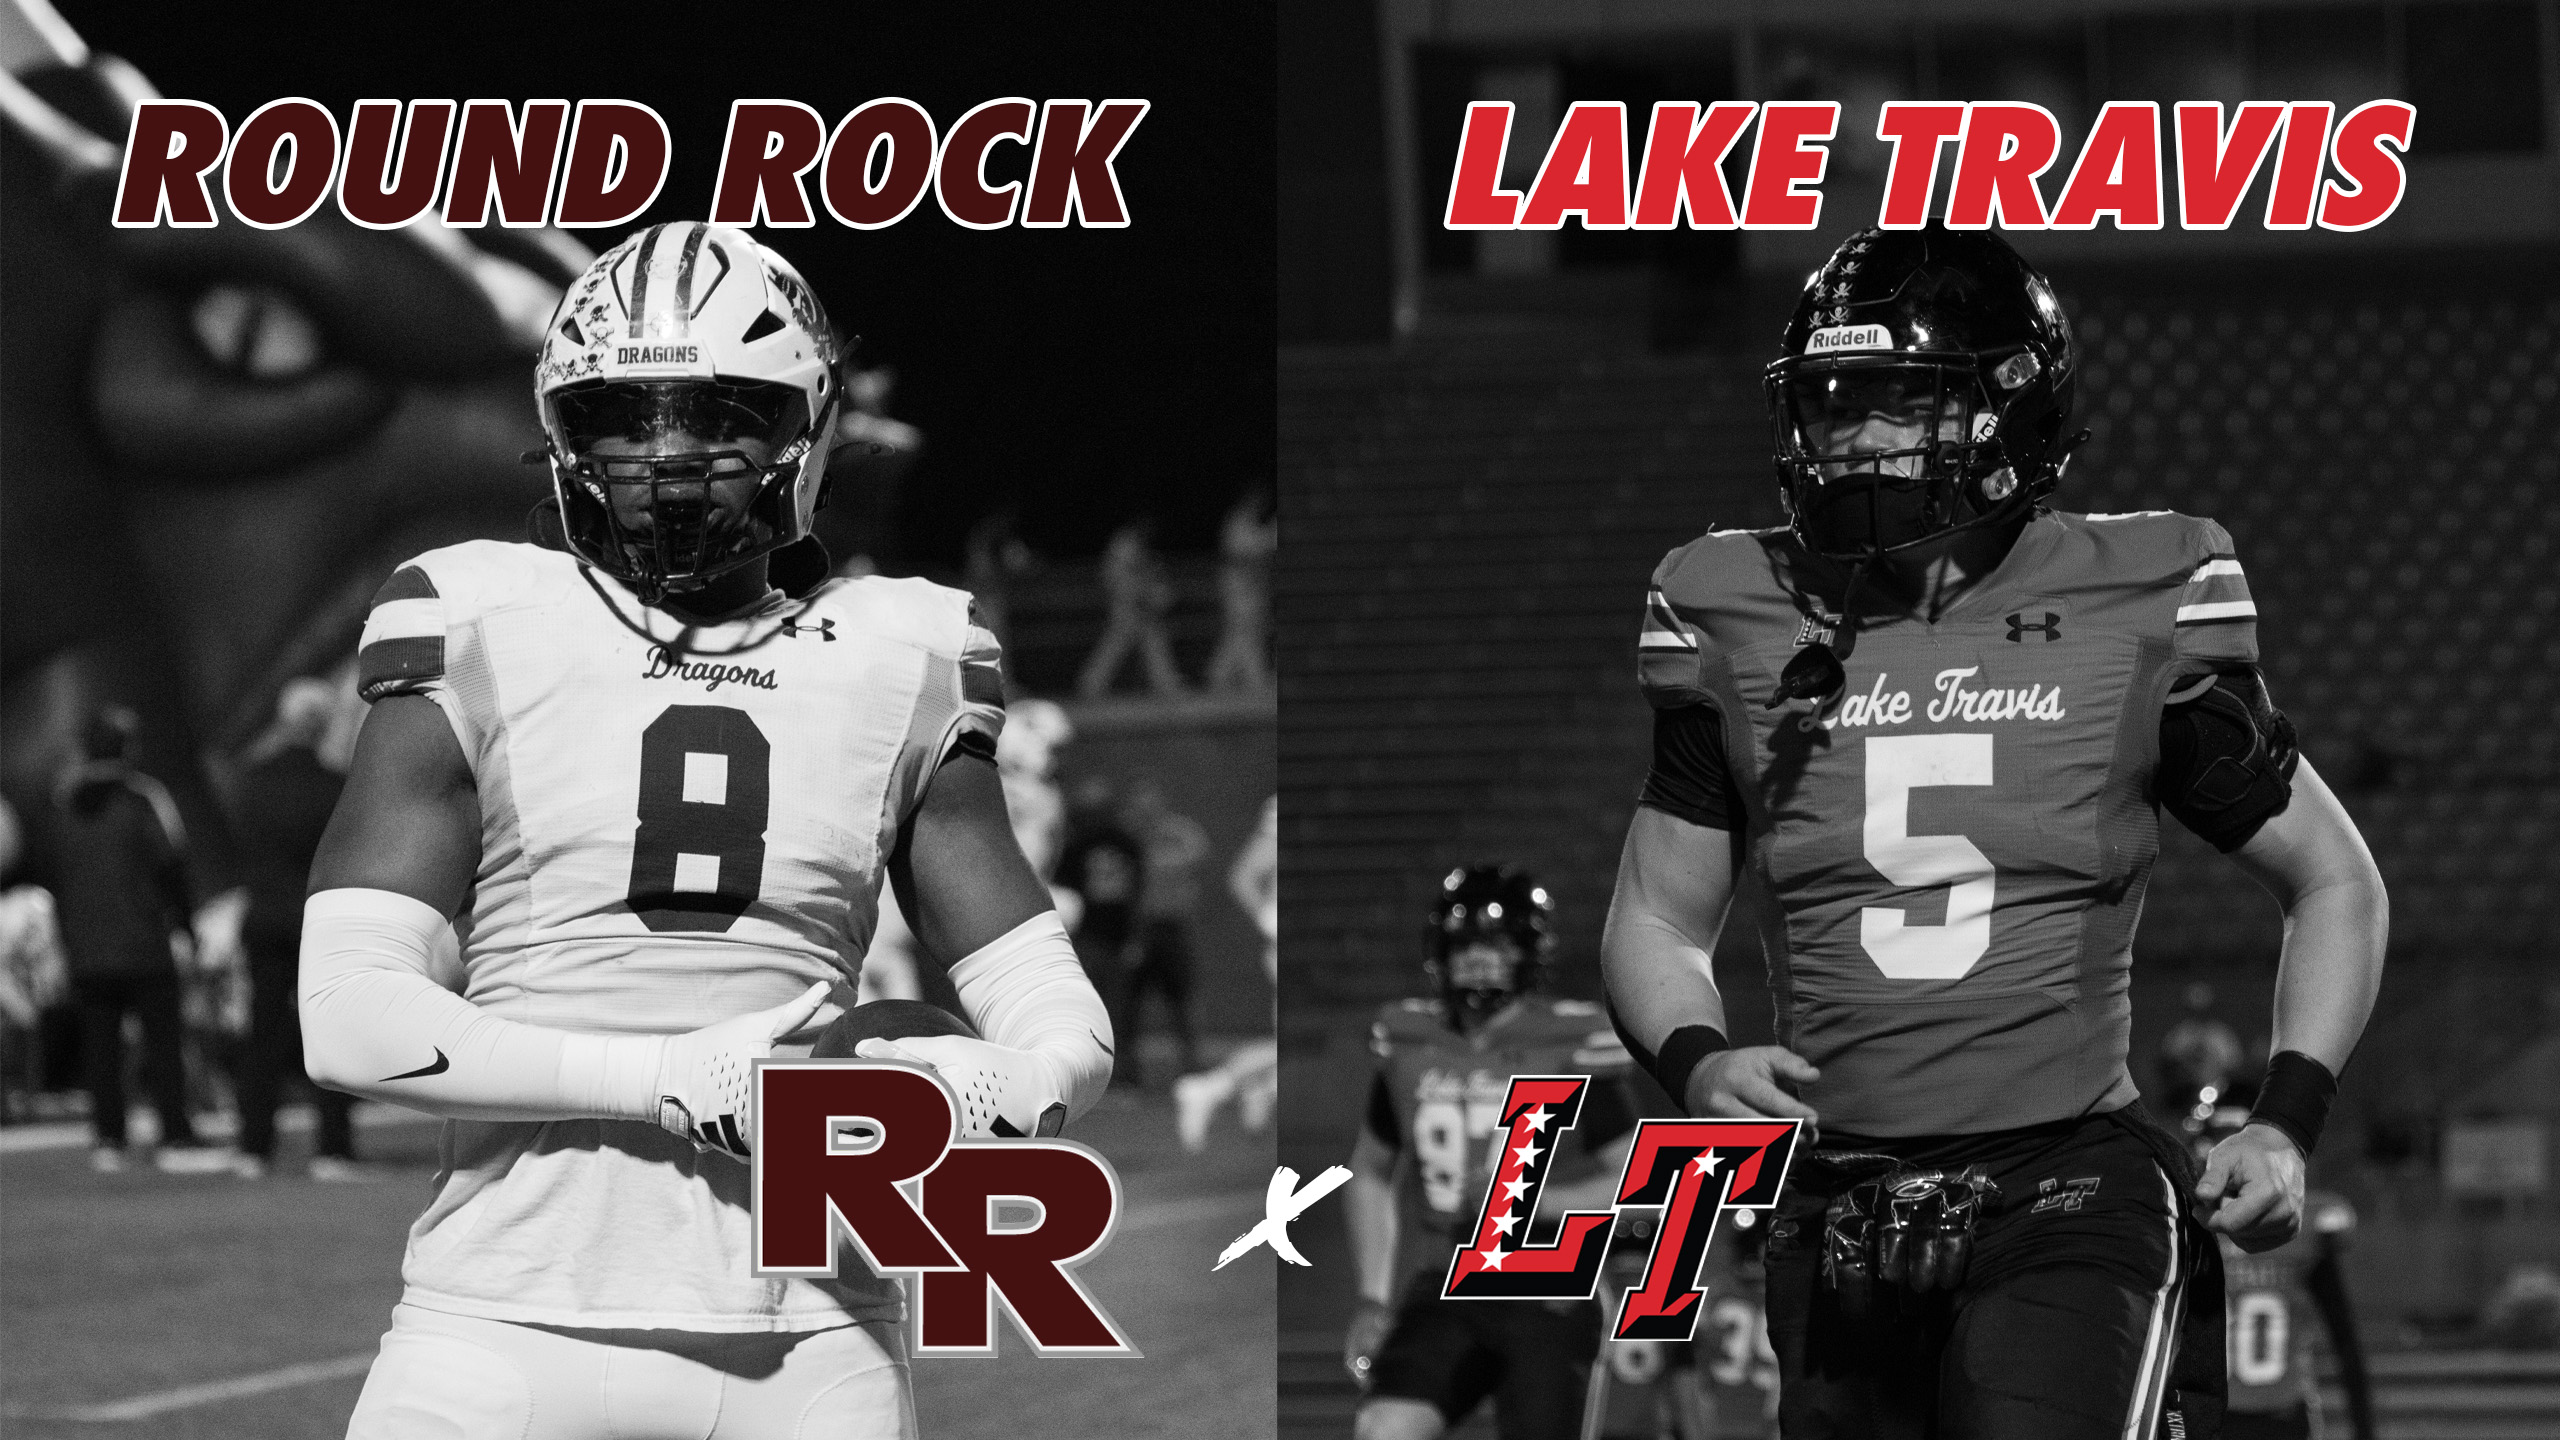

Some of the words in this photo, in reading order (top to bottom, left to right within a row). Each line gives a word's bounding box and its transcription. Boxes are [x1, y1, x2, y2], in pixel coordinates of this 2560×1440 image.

[617, 346, 698, 364] DRAGONS
[1813, 329, 1878, 349] Riddell
[1975, 414, 1999, 443] dell
[642, 645, 778, 692] Dragons
[1798, 672, 1912, 732] Lake
[1927, 665, 2066, 723] Travis
[627, 703, 771, 933] 8
[1860, 732, 1996, 980] 5
[2031, 1177, 2100, 1214] LT
